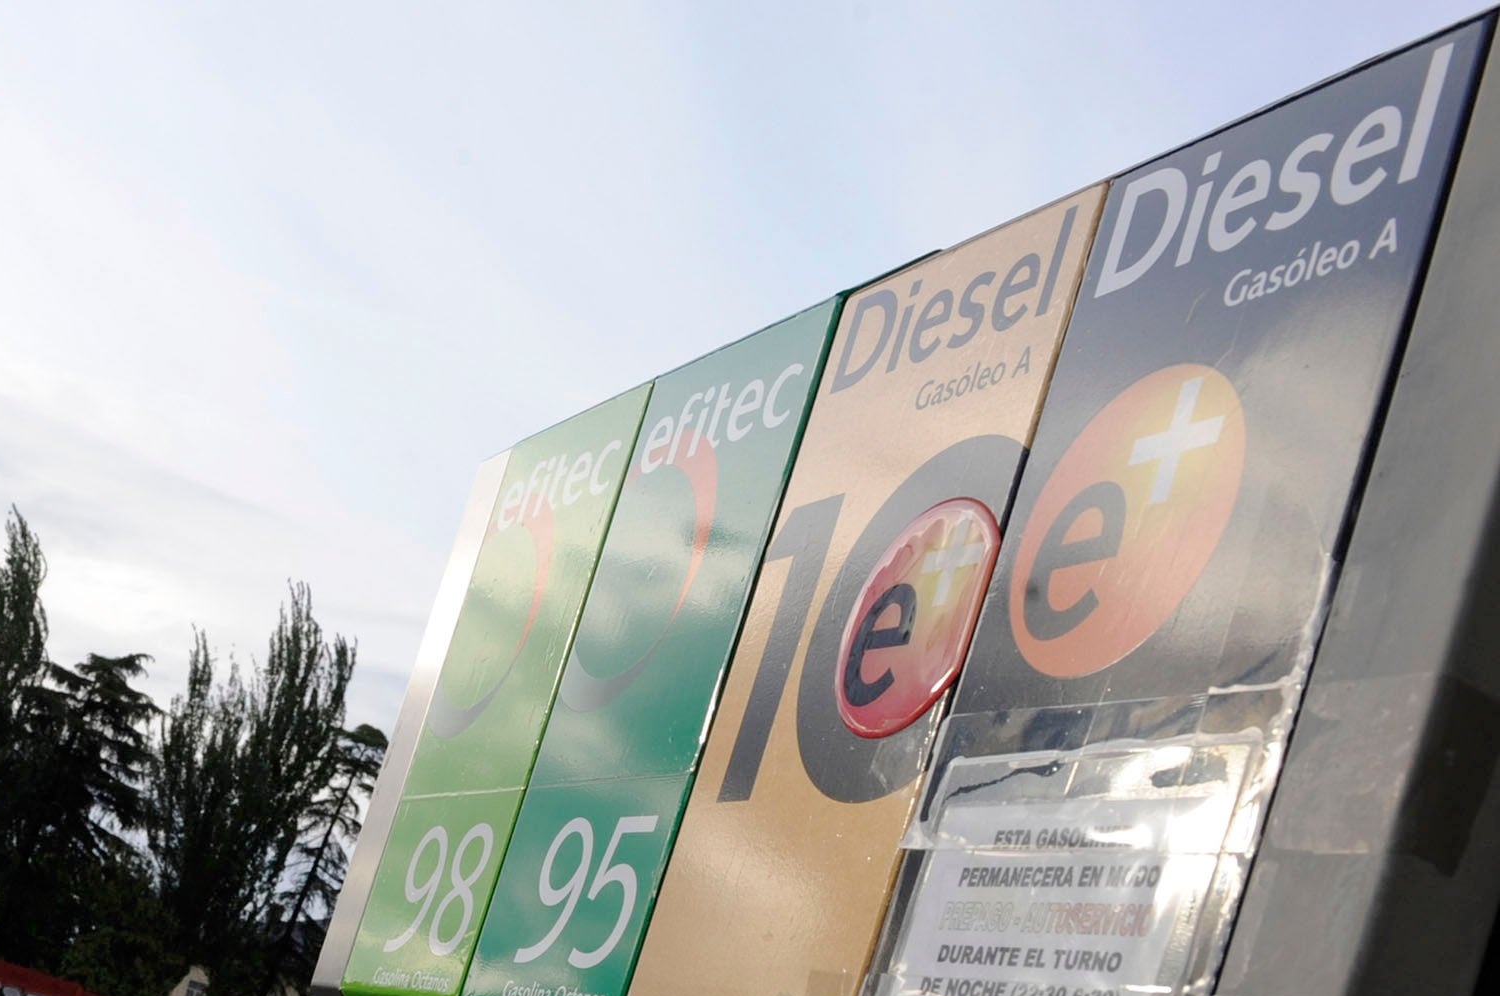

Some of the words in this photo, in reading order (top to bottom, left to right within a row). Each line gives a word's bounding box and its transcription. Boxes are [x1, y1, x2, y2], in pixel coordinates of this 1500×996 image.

[1093, 42, 1455, 299] Diesel
[830, 205, 1078, 395] Diesel
[1222, 238, 1358, 308] Gasóleo
[1367, 217, 1398, 260] A
[640, 363, 804, 475] efitec
[914, 361, 1007, 412] Gasóleo
[1011, 353, 1031, 377] A
[496, 440, 622, 531] efitec
[993, 828, 1032, 849] ESTA
[383, 823, 495, 957] 98
[513, 815, 659, 969] 95
[958, 865, 1074, 889] PERMANECERA
[1078, 865, 1104, 887] EN
[938, 900, 1011, 933] PREPAGO
[1021, 902, 1156, 938] AUTOSERVICIO
[372, 966, 410, 989] Gasolina
[411, 967, 451, 993] Octanos
[919, 976, 941, 996] DE
[936, 945, 1020, 968] DURANTE
[1023, 948, 1045, 968] EL
[1053, 949, 1123, 973] TURNO
